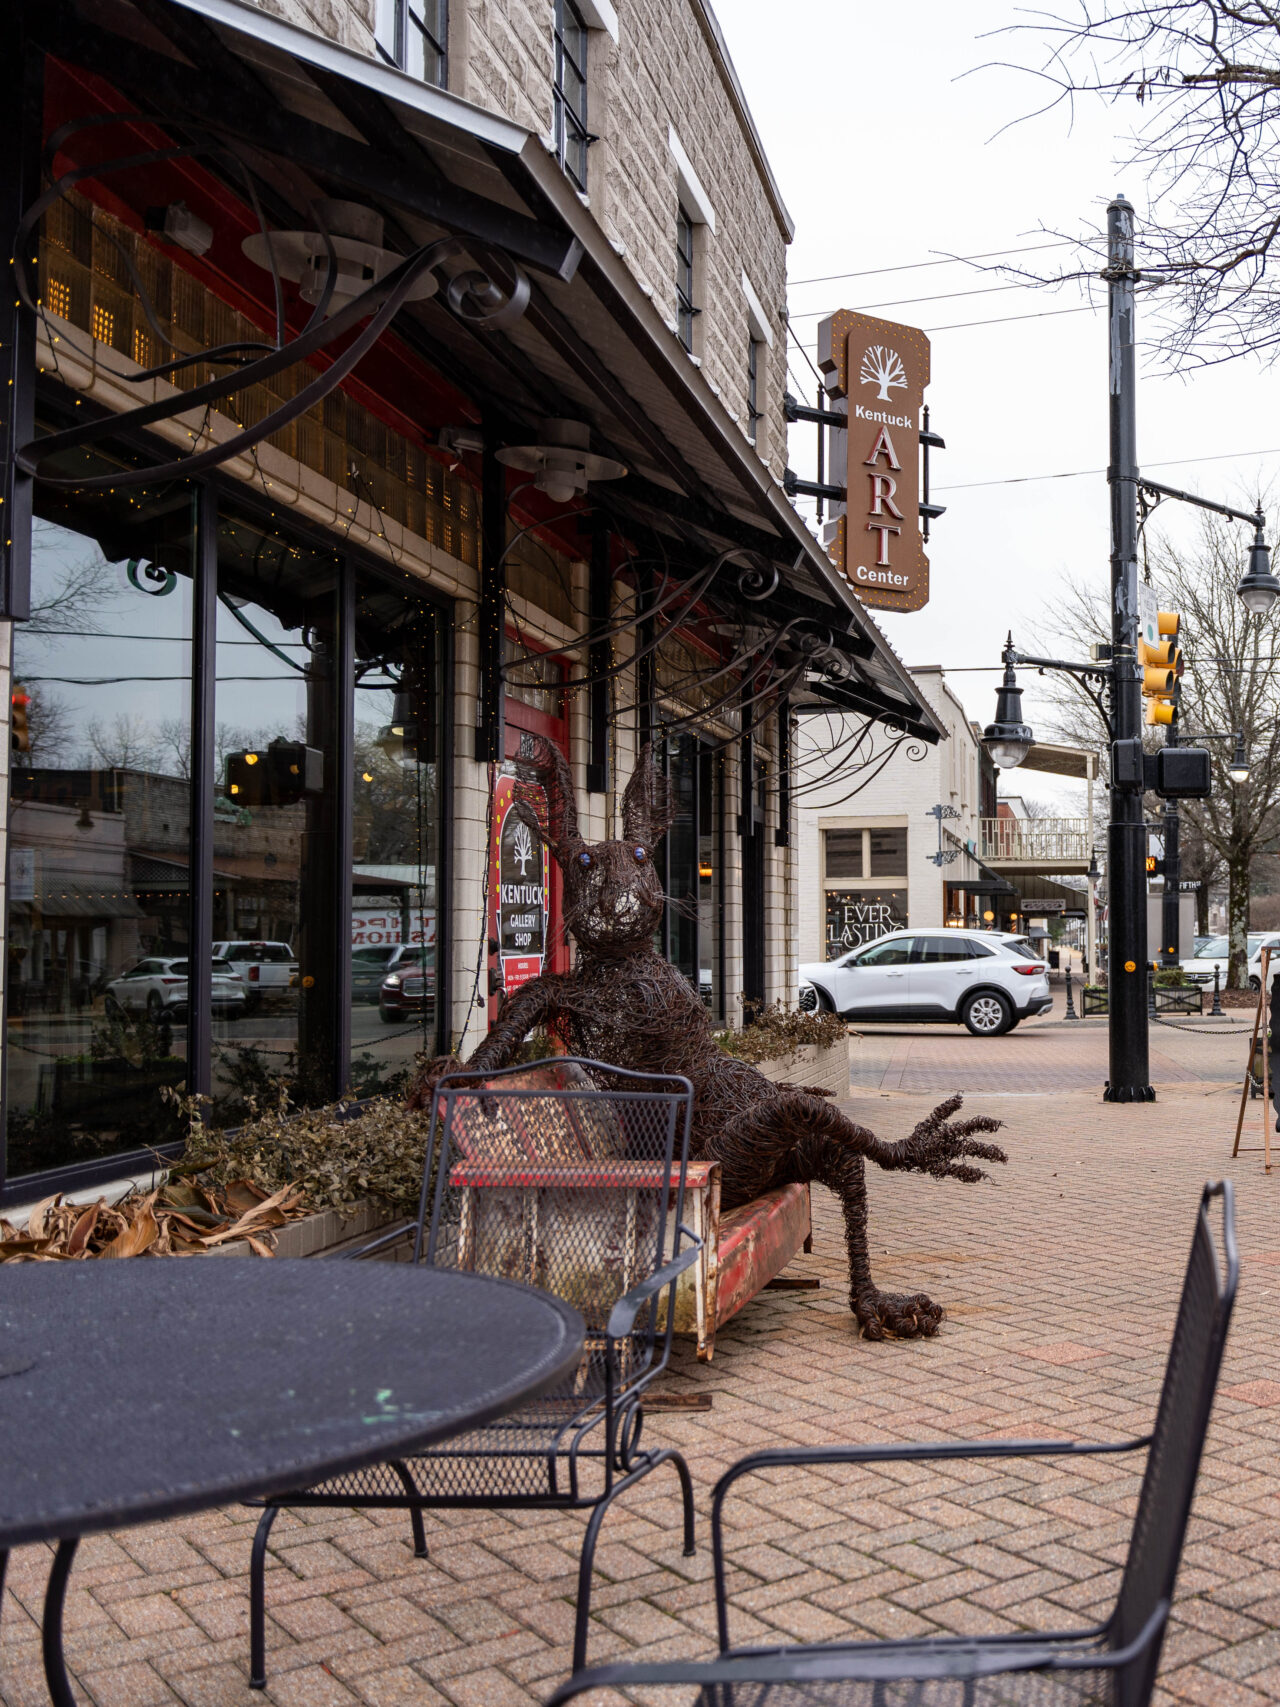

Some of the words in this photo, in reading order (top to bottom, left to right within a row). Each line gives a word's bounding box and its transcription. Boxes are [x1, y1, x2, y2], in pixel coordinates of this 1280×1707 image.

[855, 404, 913, 429] Kentuck
[862, 425, 905, 566] ART
[856, 565, 909, 587] Center
[501, 884, 544, 905] KENTUCK
[1179, 881, 1196, 890] FIFTH
[510, 914, 536, 928] GALLERY
[844, 905, 901, 926] EVER
[515, 932, 532, 946] SHOP
